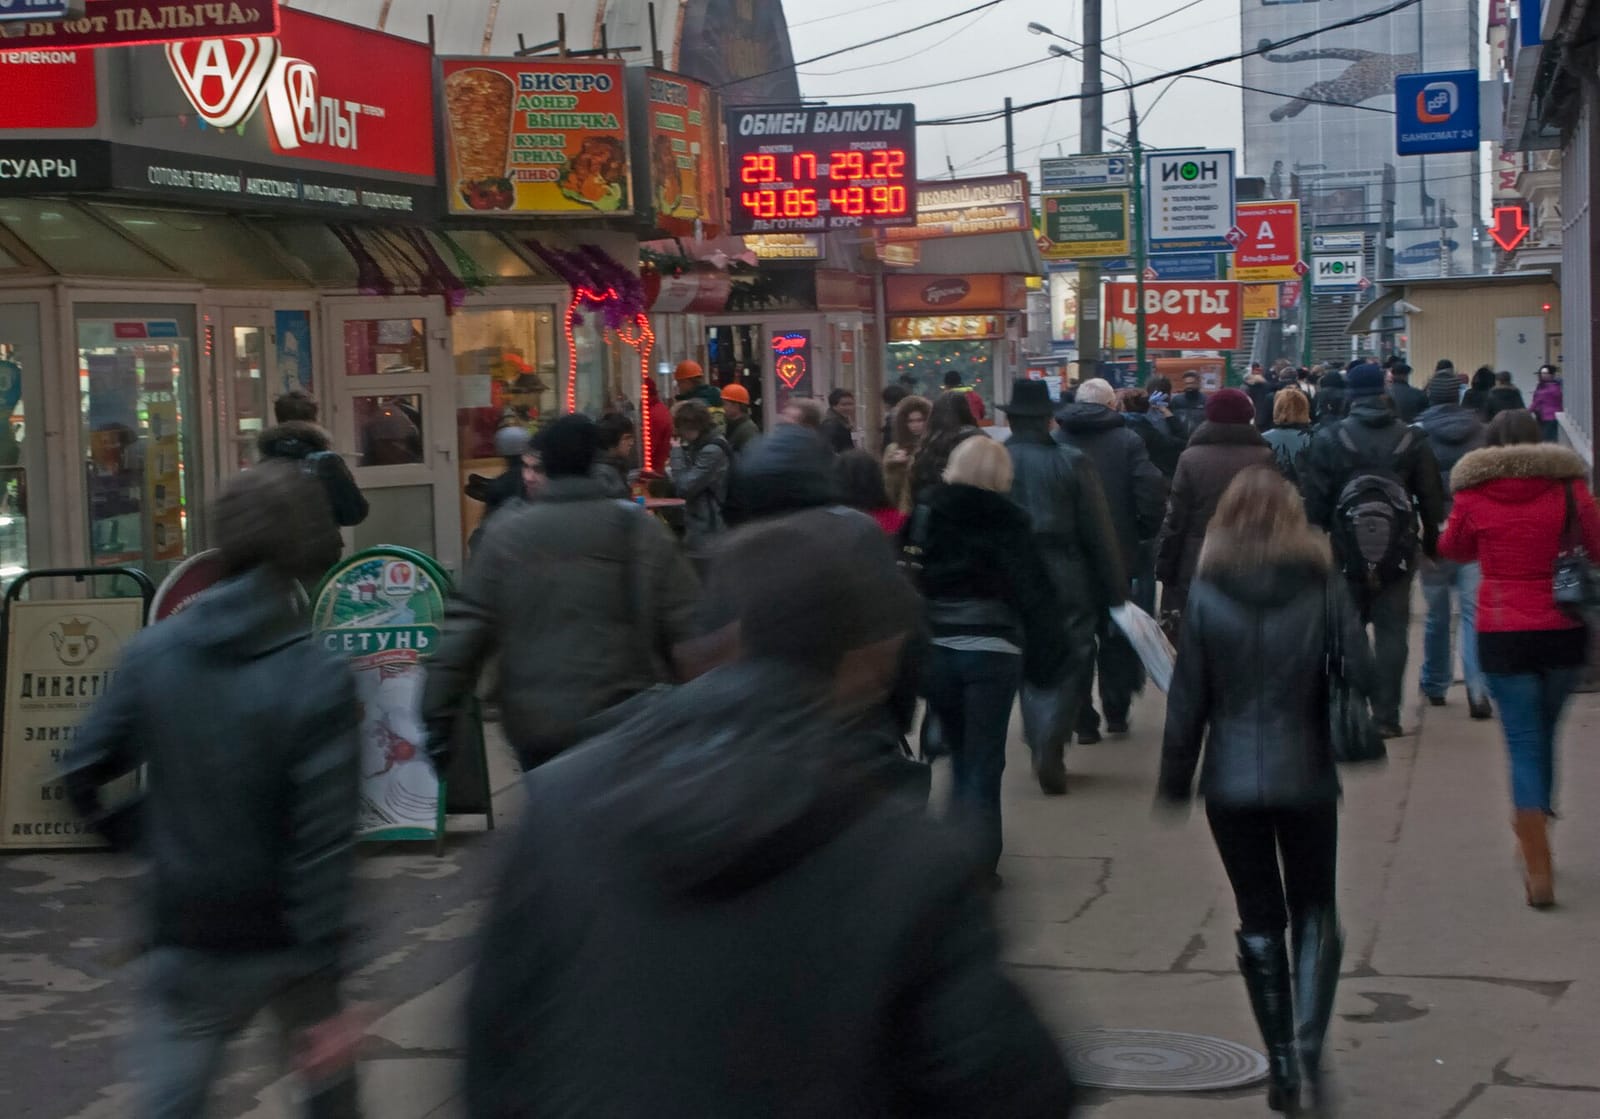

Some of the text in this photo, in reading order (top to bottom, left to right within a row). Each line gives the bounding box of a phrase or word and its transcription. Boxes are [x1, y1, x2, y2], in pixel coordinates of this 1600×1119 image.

[115, 2, 260, 31] ПАЛЫЧА»
[519, 73, 611, 92] БИСТРО
[517, 95, 578, 111] ДОНЕР
[527, 113, 619, 129] ВЫПЕЧКА
[739, 109, 903, 136] ОБМЕН ВАЛЮТЫ
[515, 134, 566, 148] КУРЫ
[1401, 130, 1474, 142] БАНКОМАТ 24
[512, 150, 567, 163] ГРИЛЬ
[515, 168, 560, 181] ПИВО
[741, 150, 906, 183] 29.17 29.22
[1162, 161, 1217, 182] ИОН
[741, 188, 818, 217] 43.85
[830, 185, 906, 214] 43.90
[917, 184, 970, 207] лковый
[752, 216, 825, 230] ЛЬГОТНЫЙ
[830, 216, 864, 228] КУРС
[1256, 221, 1275, 240] А
[1242, 254, 1290, 262] Альфа-Банк
[1319, 261, 1356, 274] ИОН
[1147, 323, 1170, 341] 24
[324, 630, 429, 651] СЕТУНЬ
[41, 785, 65, 801] КО
